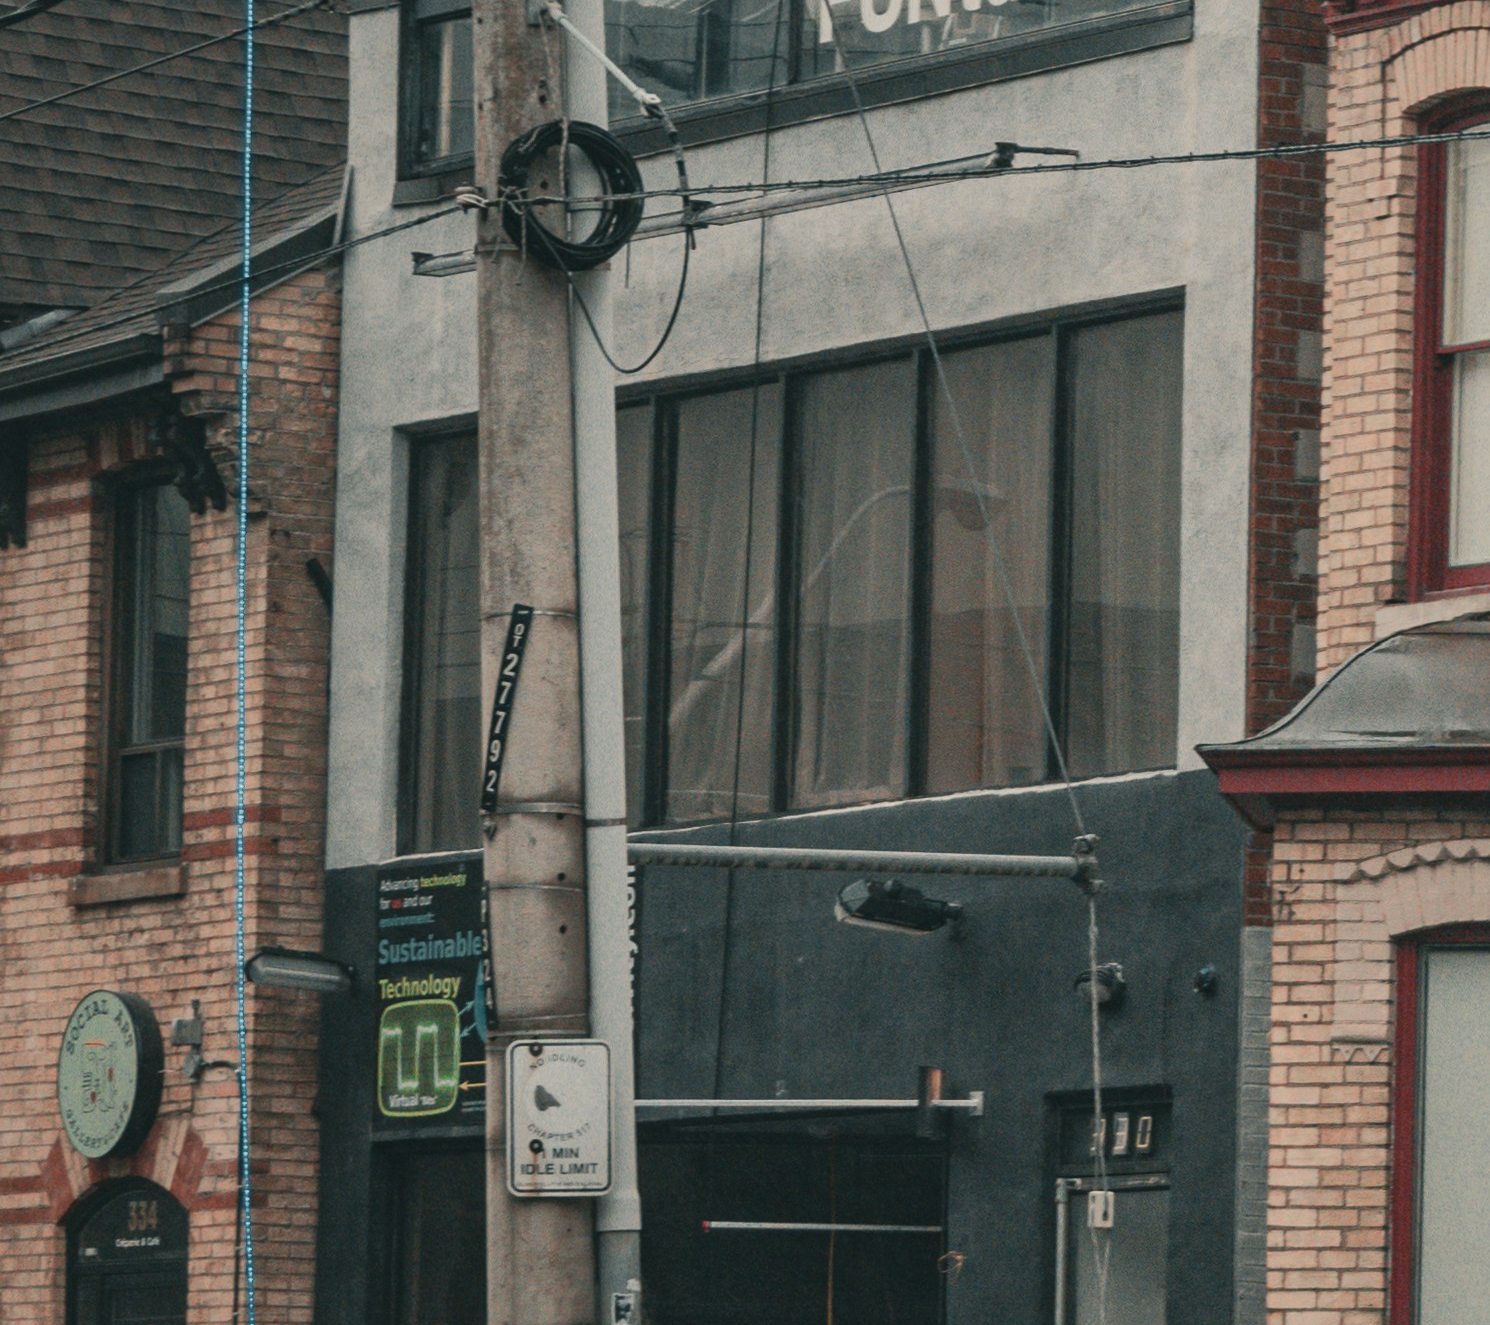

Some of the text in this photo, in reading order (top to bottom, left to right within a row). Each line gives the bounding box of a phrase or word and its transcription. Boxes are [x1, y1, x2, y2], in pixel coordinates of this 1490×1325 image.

[378, 929, 482, 965] Sustainable
[379, 974, 462, 999] Technology
[65, 999, 109, 1055] SOCIAL
[552, 1147, 580, 1159] MIN
[520, 1162, 599, 1175] IDLE LIMIT
[127, 1200, 158, 1231] 334
